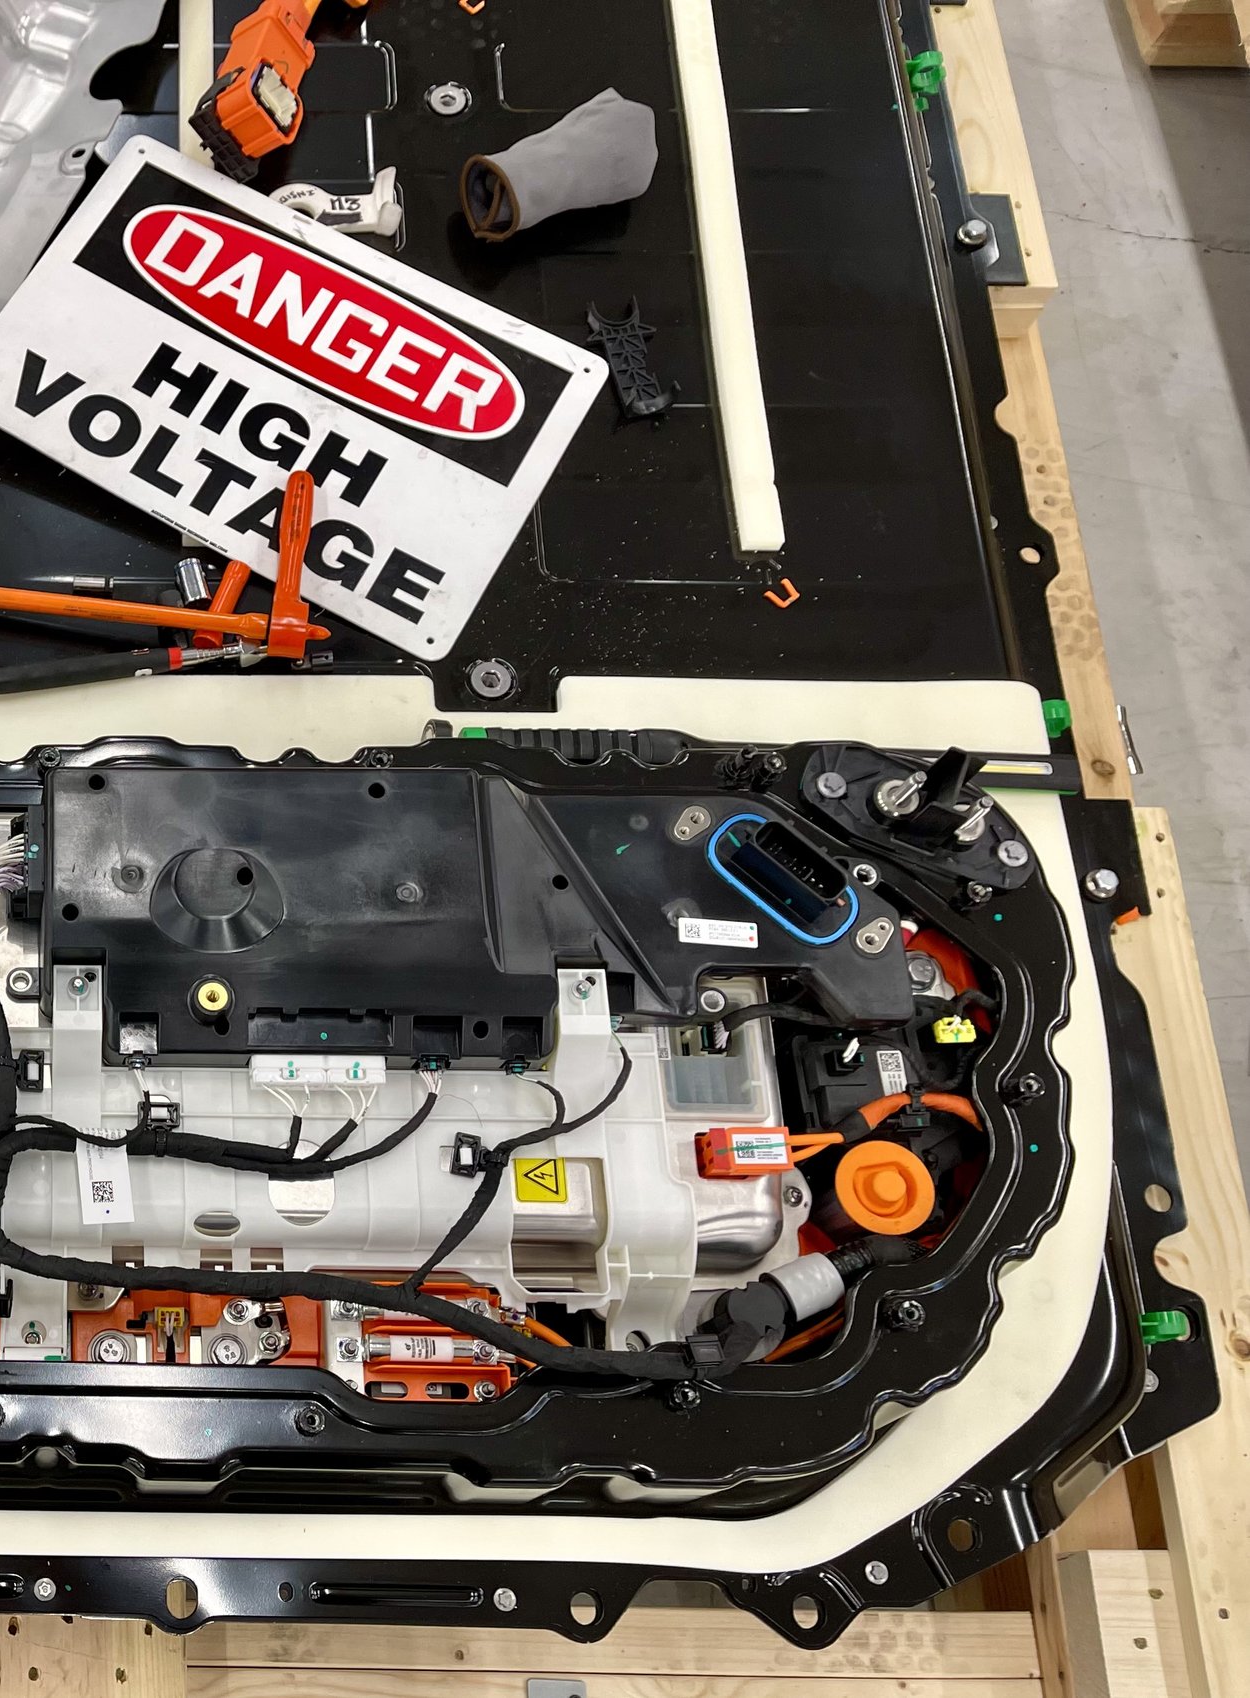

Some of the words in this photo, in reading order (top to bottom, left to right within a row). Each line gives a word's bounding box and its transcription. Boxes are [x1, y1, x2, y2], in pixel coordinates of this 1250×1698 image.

[278, 189, 316, 205] INSID
[143, 212, 504, 431] DANGER
[14, 348, 446, 625] VOLTAGE
[132, 342, 389, 507] HIGH
